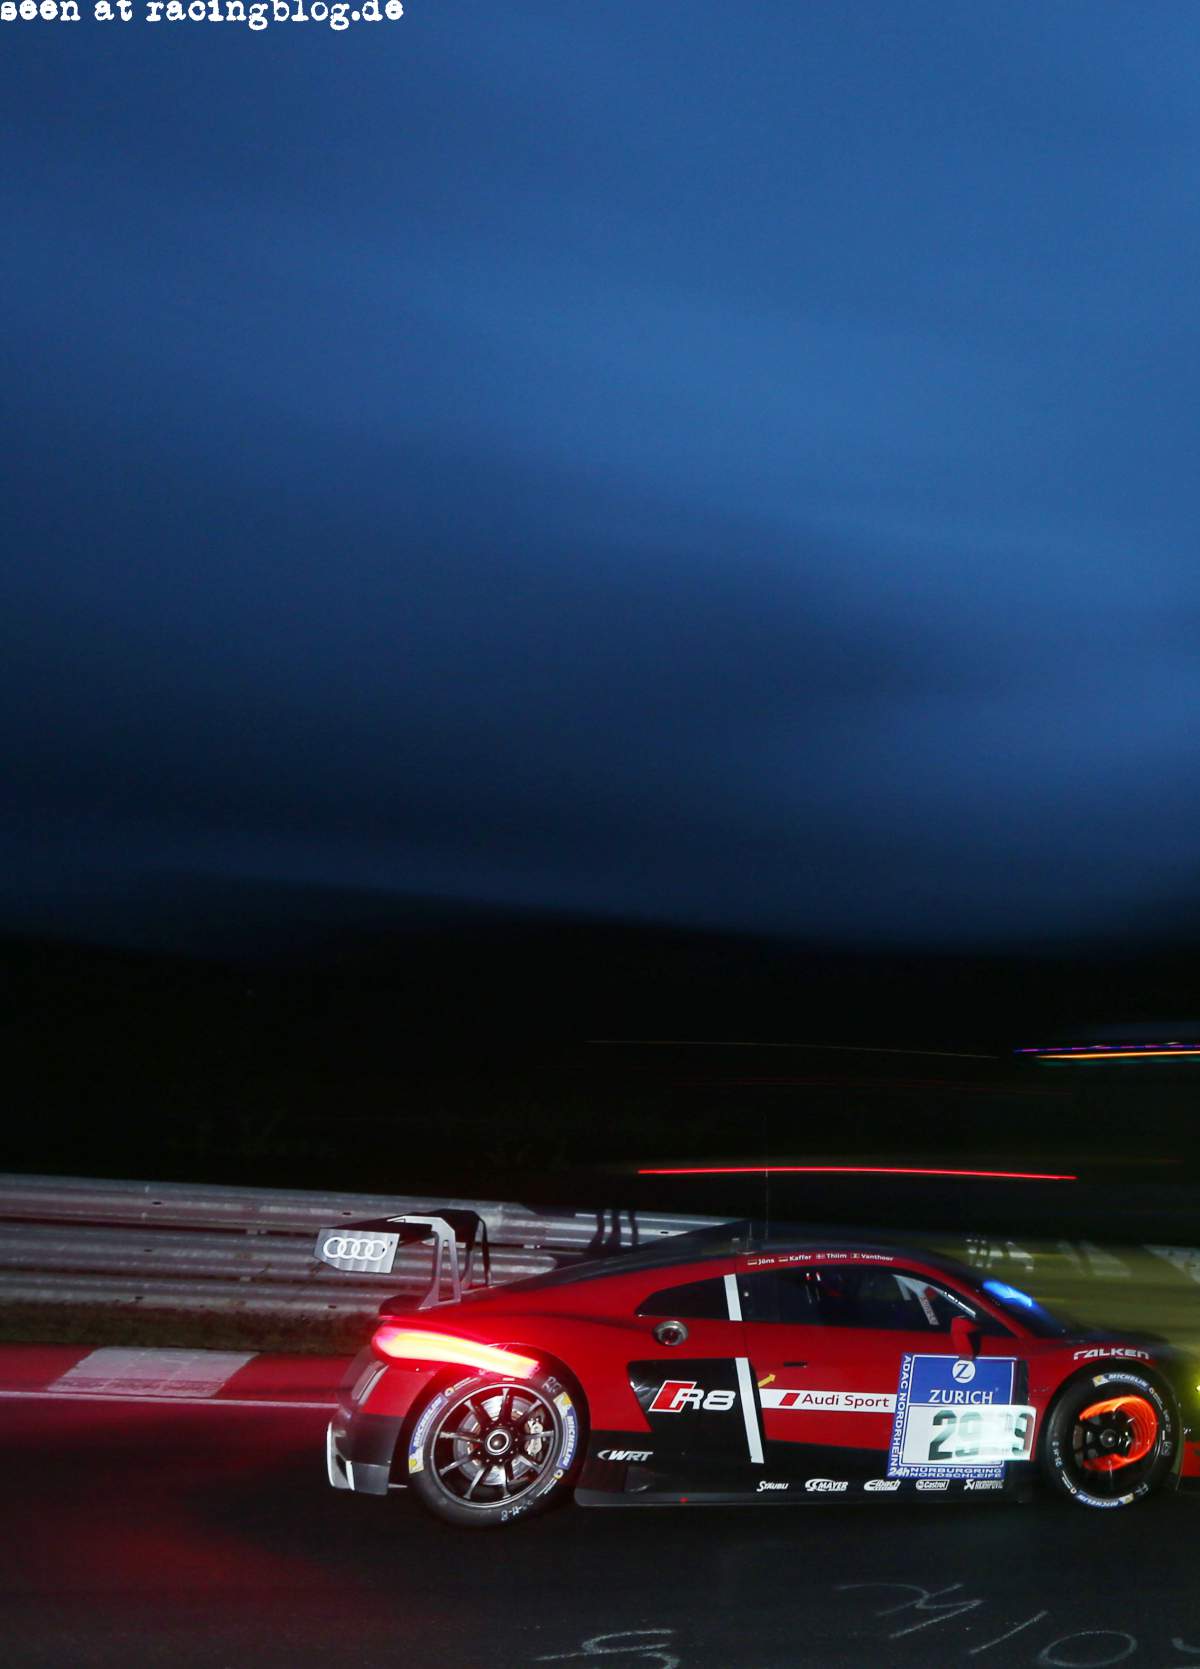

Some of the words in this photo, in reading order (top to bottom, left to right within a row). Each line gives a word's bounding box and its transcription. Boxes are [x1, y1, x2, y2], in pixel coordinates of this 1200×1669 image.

[789, 1254, 812, 1262] Kaffer
[1073, 1348, 1149, 1360] FALKEN
[900, 1355, 911, 1389] ADAC
[649, 1380, 736, 1413] R8
[801, 1393, 840, 1406] Audi
[844, 1396, 890, 1408] Sport
[928, 1390, 993, 1404] ZURICH
[890, 1392, 907, 1466] NORDRHEIN
[609, 1451, 653, 1461] WRT
